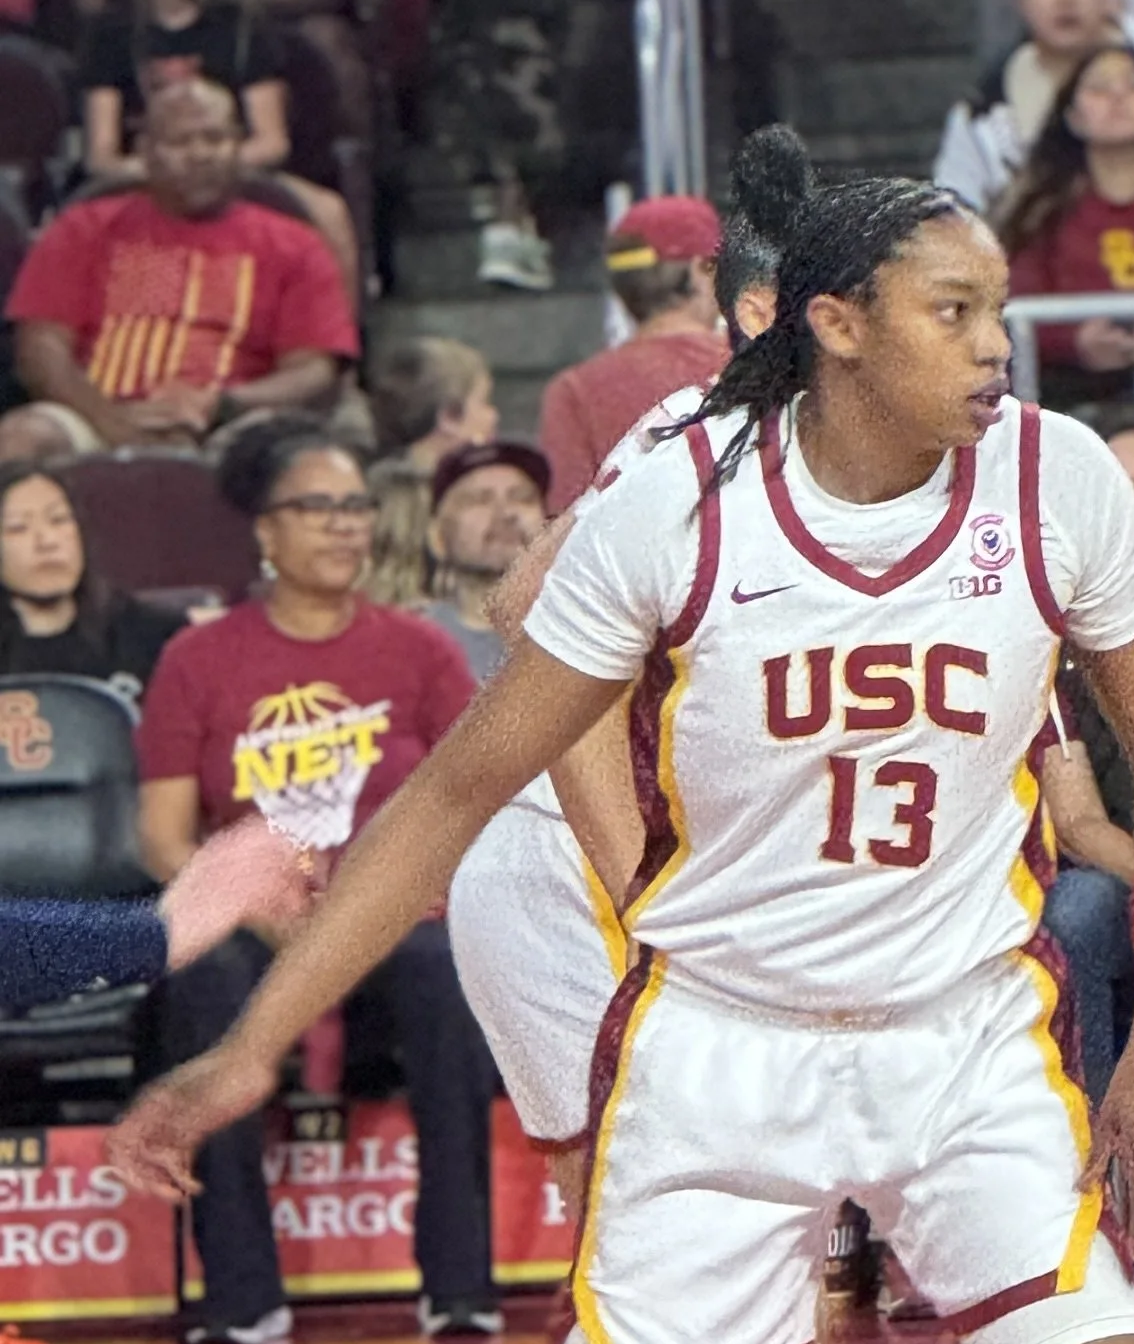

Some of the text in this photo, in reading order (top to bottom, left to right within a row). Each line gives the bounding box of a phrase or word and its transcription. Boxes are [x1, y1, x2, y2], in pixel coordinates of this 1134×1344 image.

[762, 643, 989, 739] USC
[233, 715, 390, 800] NET
[820, 756, 938, 867] 13
[0, 1219, 129, 1267] RGO
